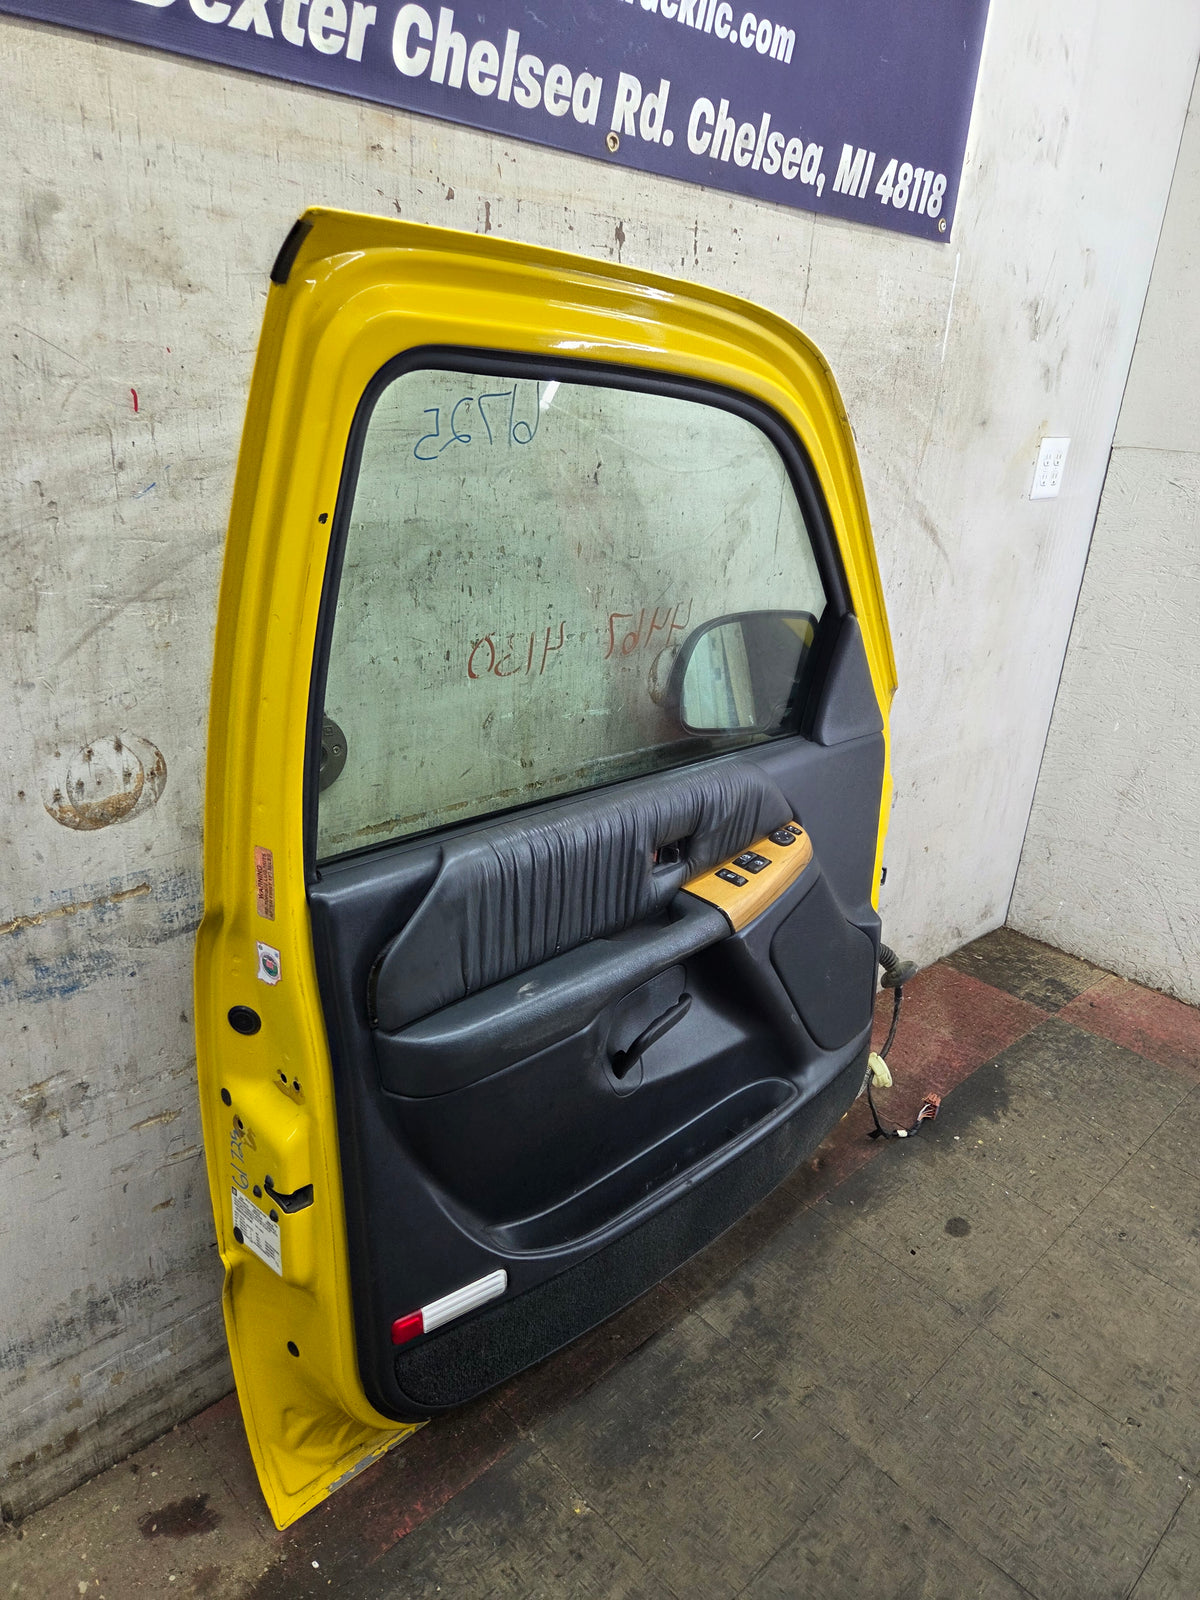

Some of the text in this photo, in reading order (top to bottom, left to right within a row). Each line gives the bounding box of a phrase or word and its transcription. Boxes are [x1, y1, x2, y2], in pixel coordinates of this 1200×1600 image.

[392, 3, 603, 125] Chelsea
[611, 72, 674, 147] Rd.
[687, 97, 826, 197] Chelsea,
[832, 143, 876, 199] MI
[875, 158, 948, 218] 48118
